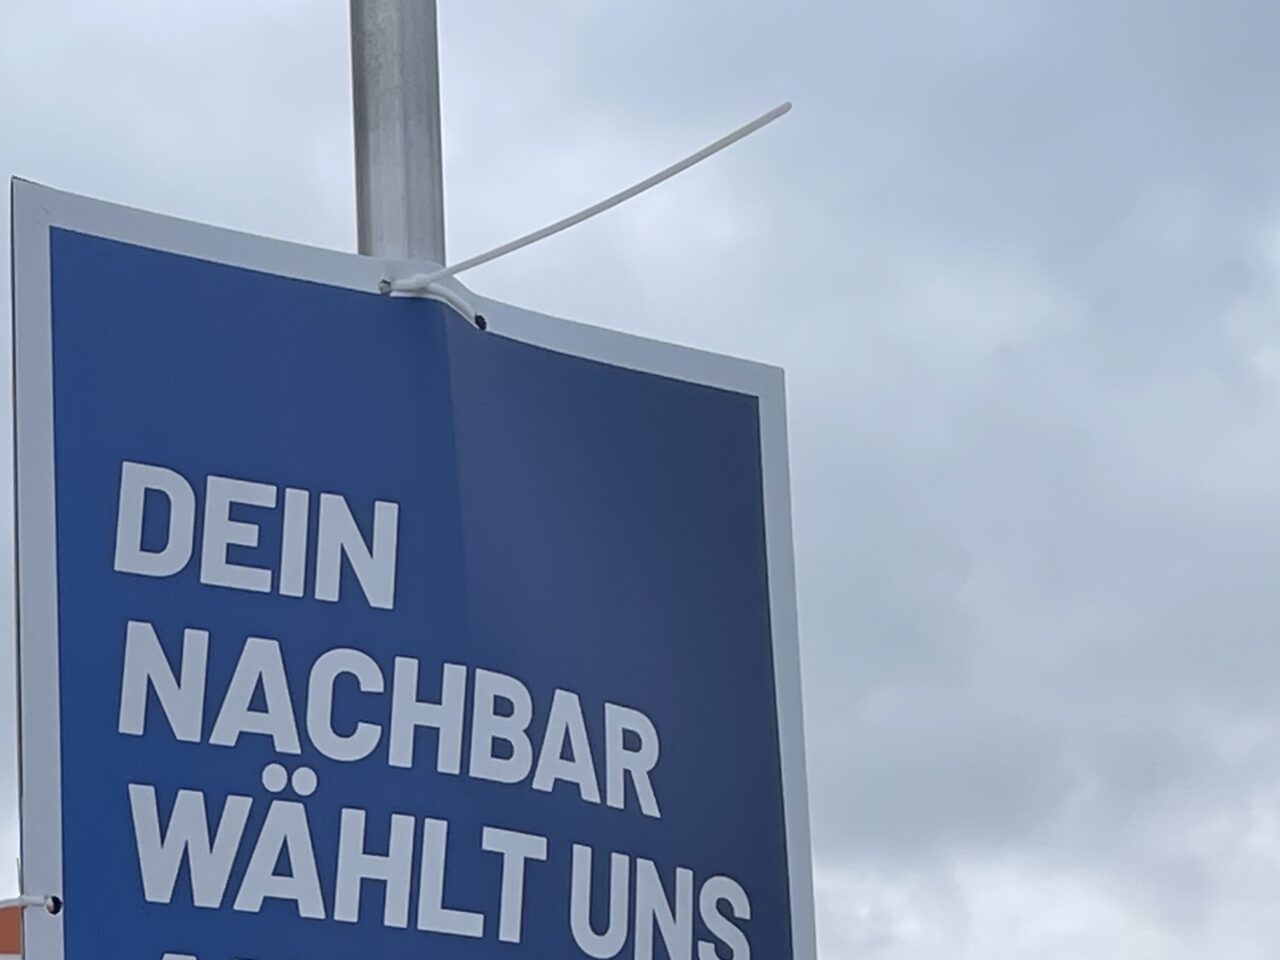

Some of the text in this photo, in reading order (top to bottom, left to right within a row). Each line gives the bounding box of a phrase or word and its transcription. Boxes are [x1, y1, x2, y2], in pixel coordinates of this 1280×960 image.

[114, 461, 399, 610] DEIN
[118, 620, 660, 818] NACHBAR
[128, 763, 547, 943] WÄHLT
